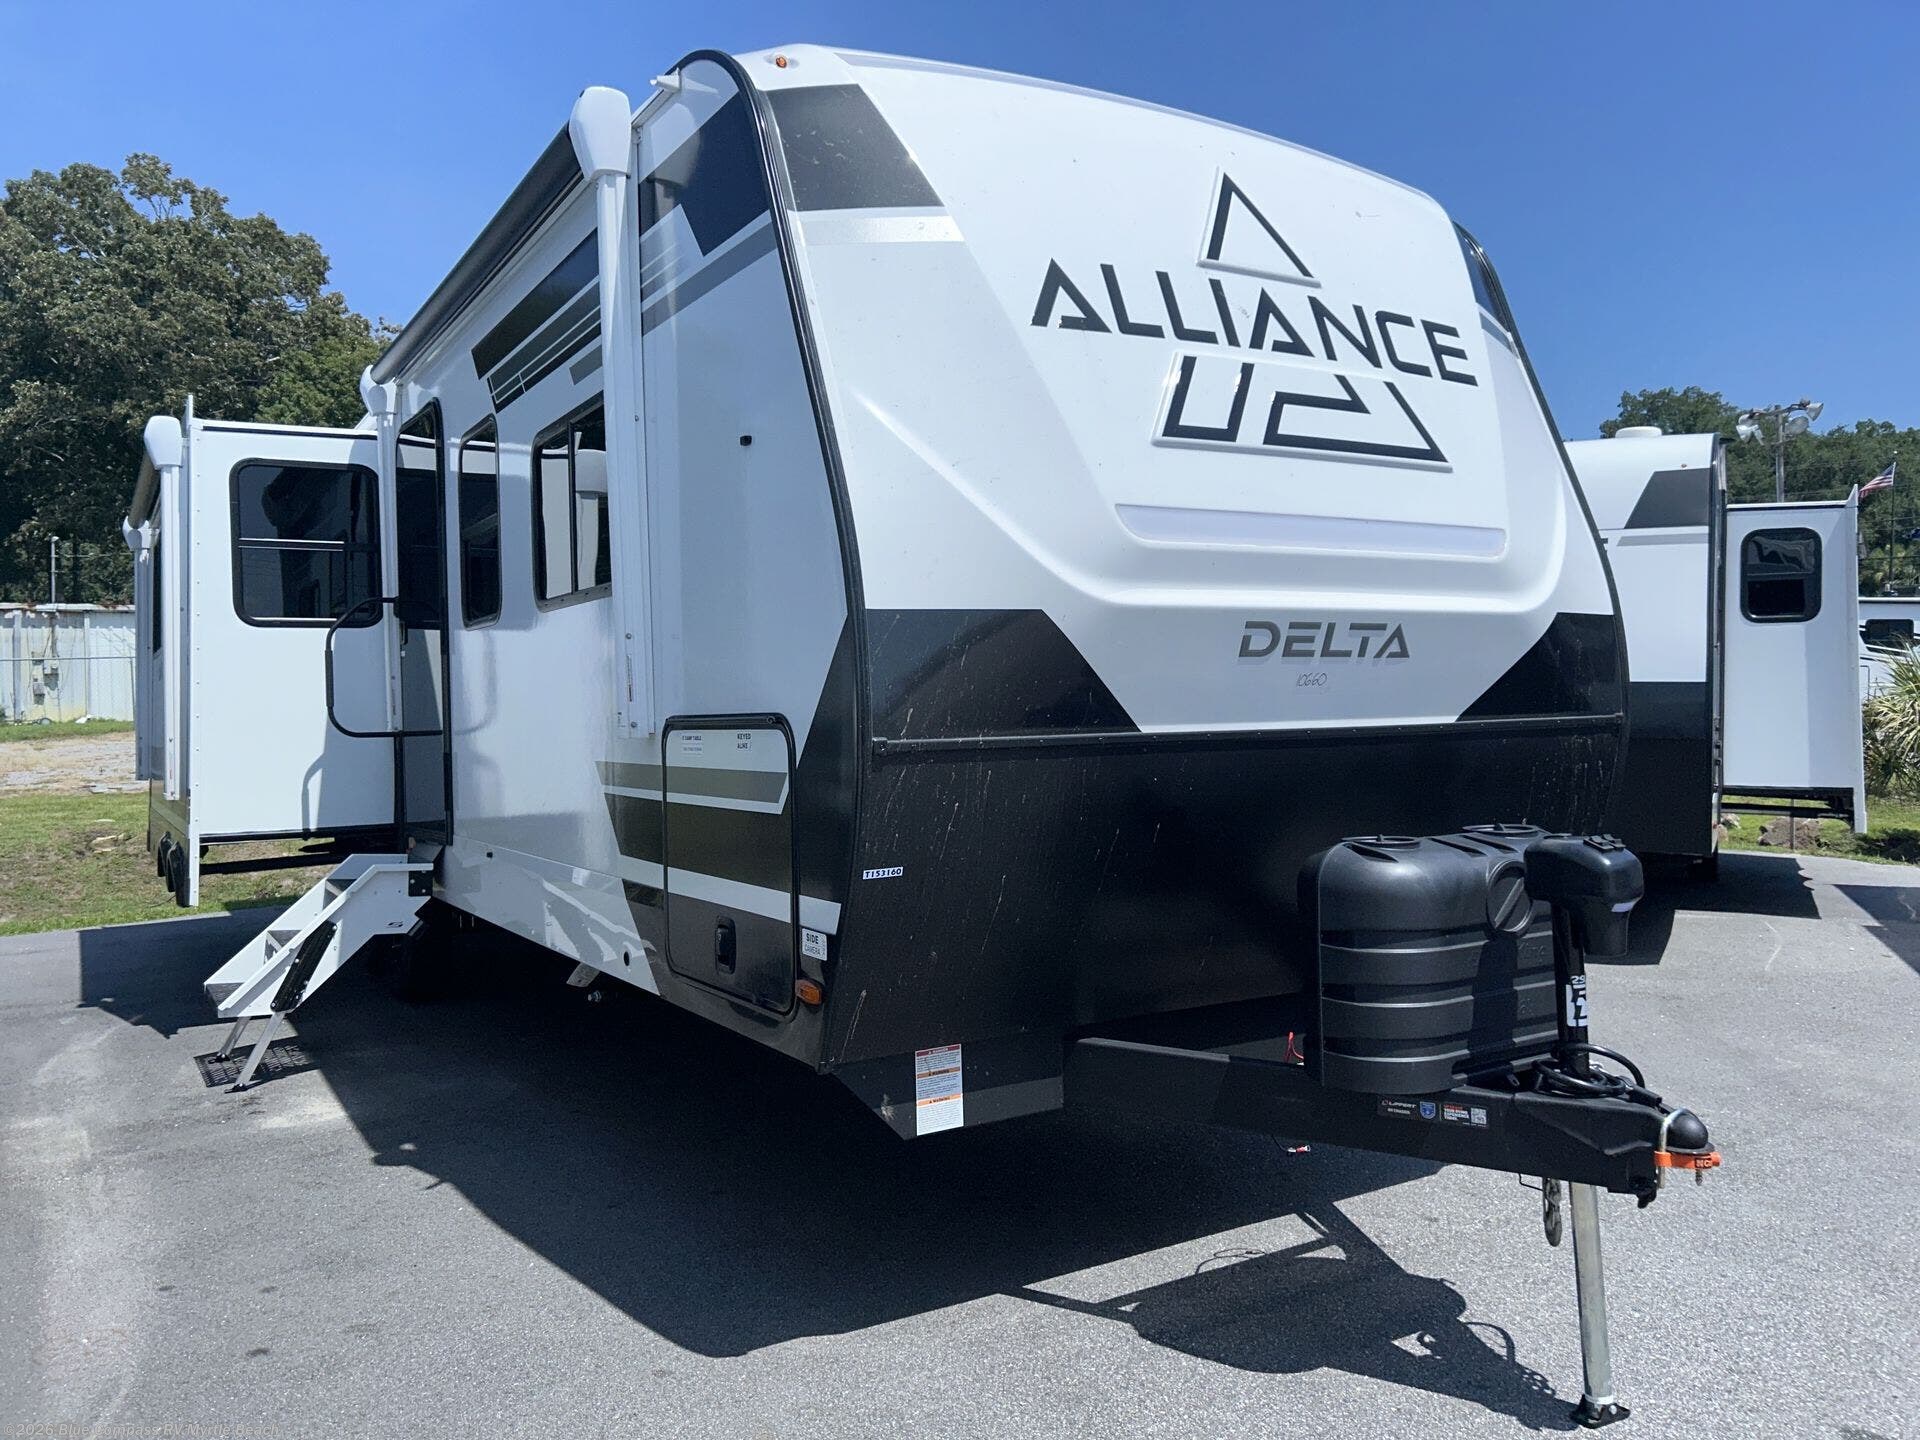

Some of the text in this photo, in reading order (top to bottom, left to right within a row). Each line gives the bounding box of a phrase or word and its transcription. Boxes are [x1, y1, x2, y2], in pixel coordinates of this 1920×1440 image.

[1030, 257, 1478, 387] ALLIANCE
[1238, 620, 1410, 659] DELTA
[864, 868, 902, 878] T153160
[806, 932, 819, 944] SIDE
